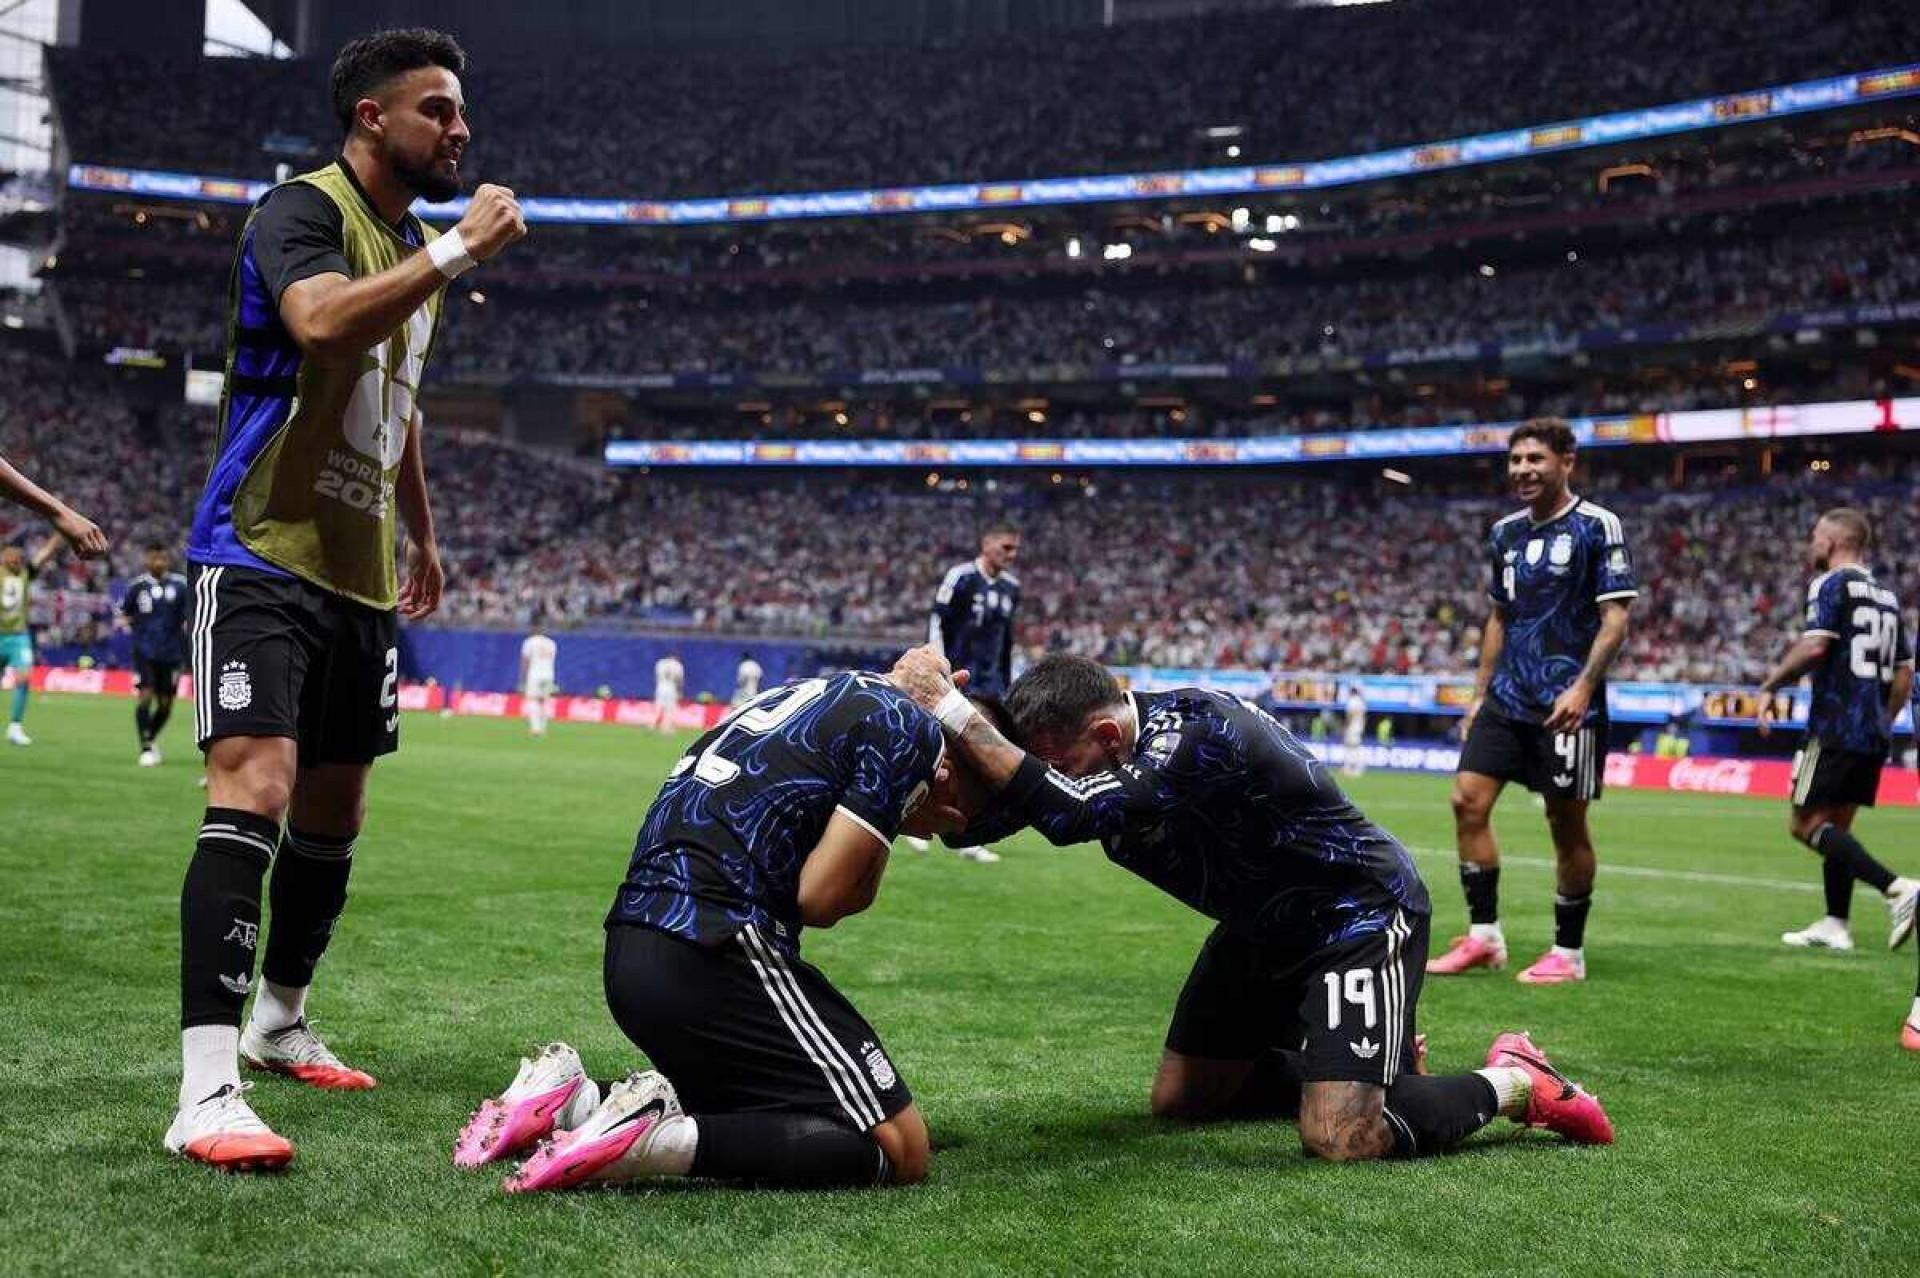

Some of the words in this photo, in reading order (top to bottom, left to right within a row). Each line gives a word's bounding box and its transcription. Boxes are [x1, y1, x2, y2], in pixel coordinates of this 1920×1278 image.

[327, 449, 384, 487] WORL
[314, 470, 387, 518] 202
[1850, 606, 1898, 682] 20
[1555, 732, 1576, 771] 4
[1323, 967, 1377, 1031] 19
